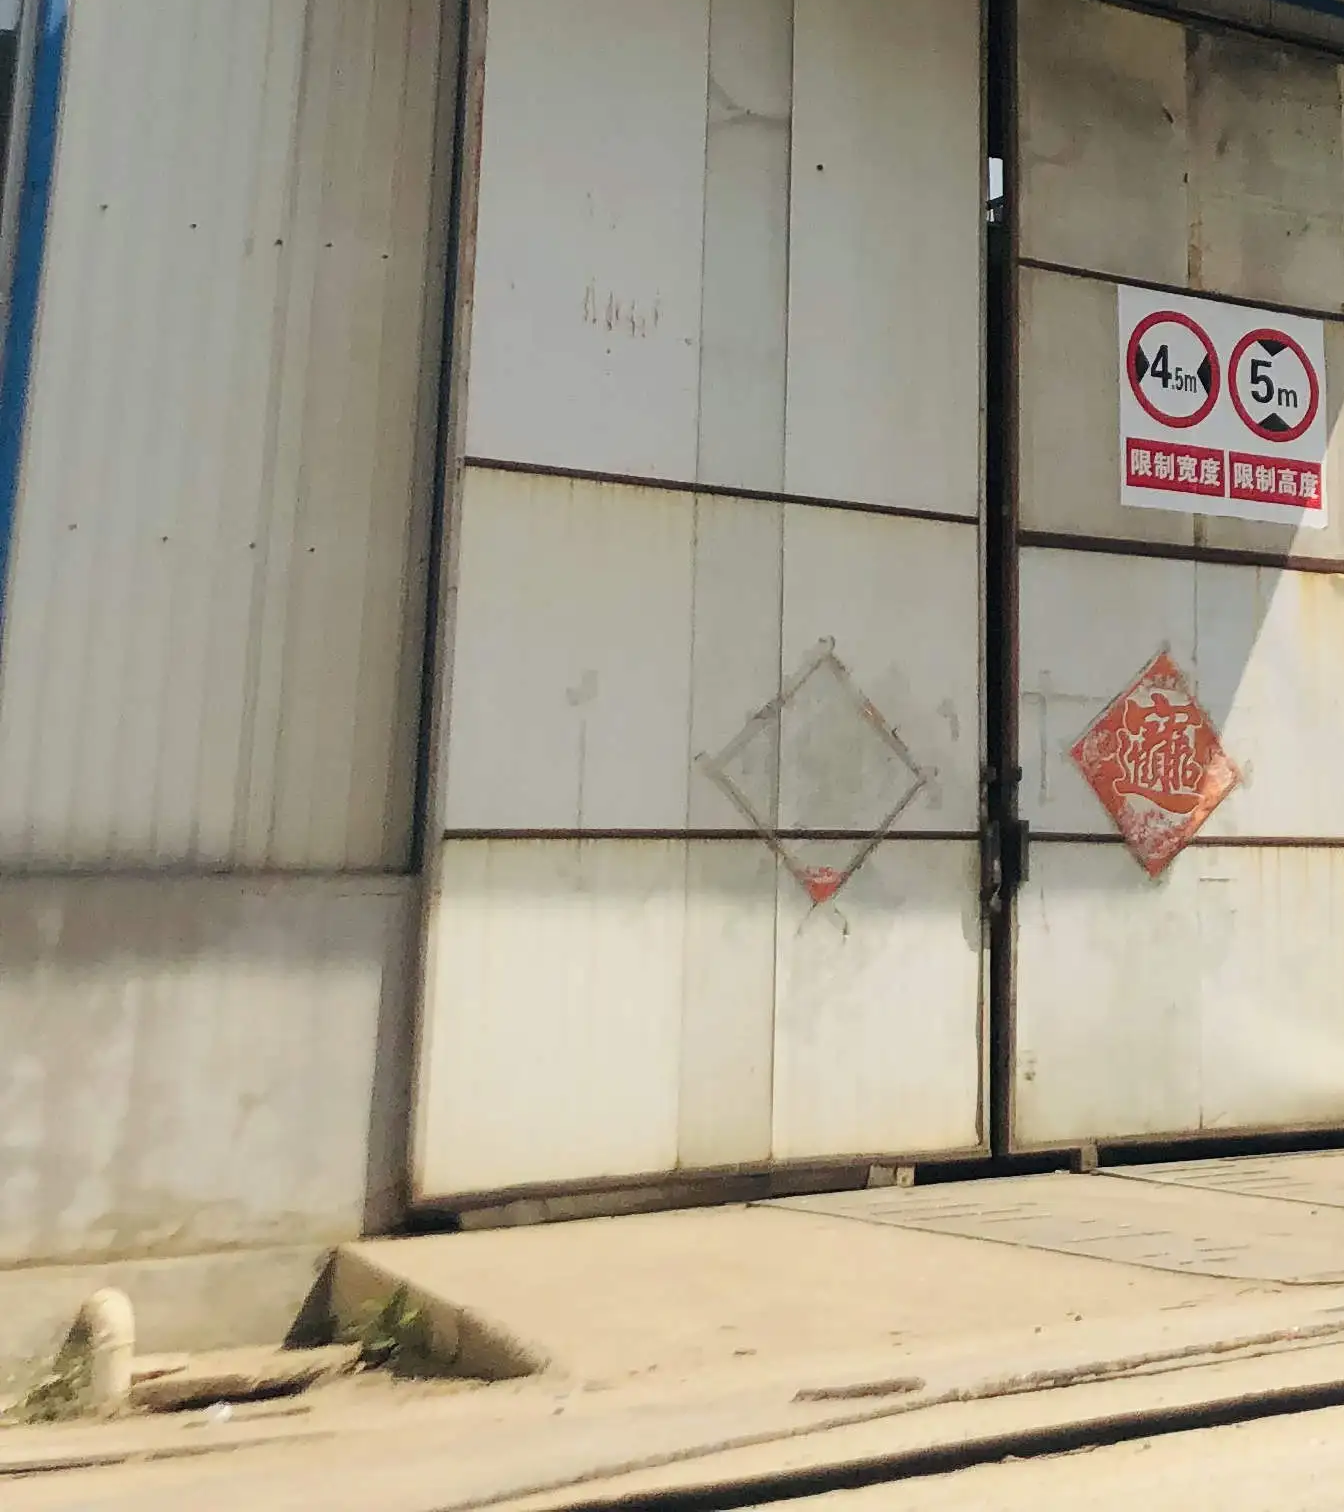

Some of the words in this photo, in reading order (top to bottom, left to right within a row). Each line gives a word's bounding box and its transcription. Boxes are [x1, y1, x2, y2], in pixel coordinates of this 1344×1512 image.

[1130, 448, 1221, 487] 限制宽度
[1233, 462, 1319, 499] 限制高度
